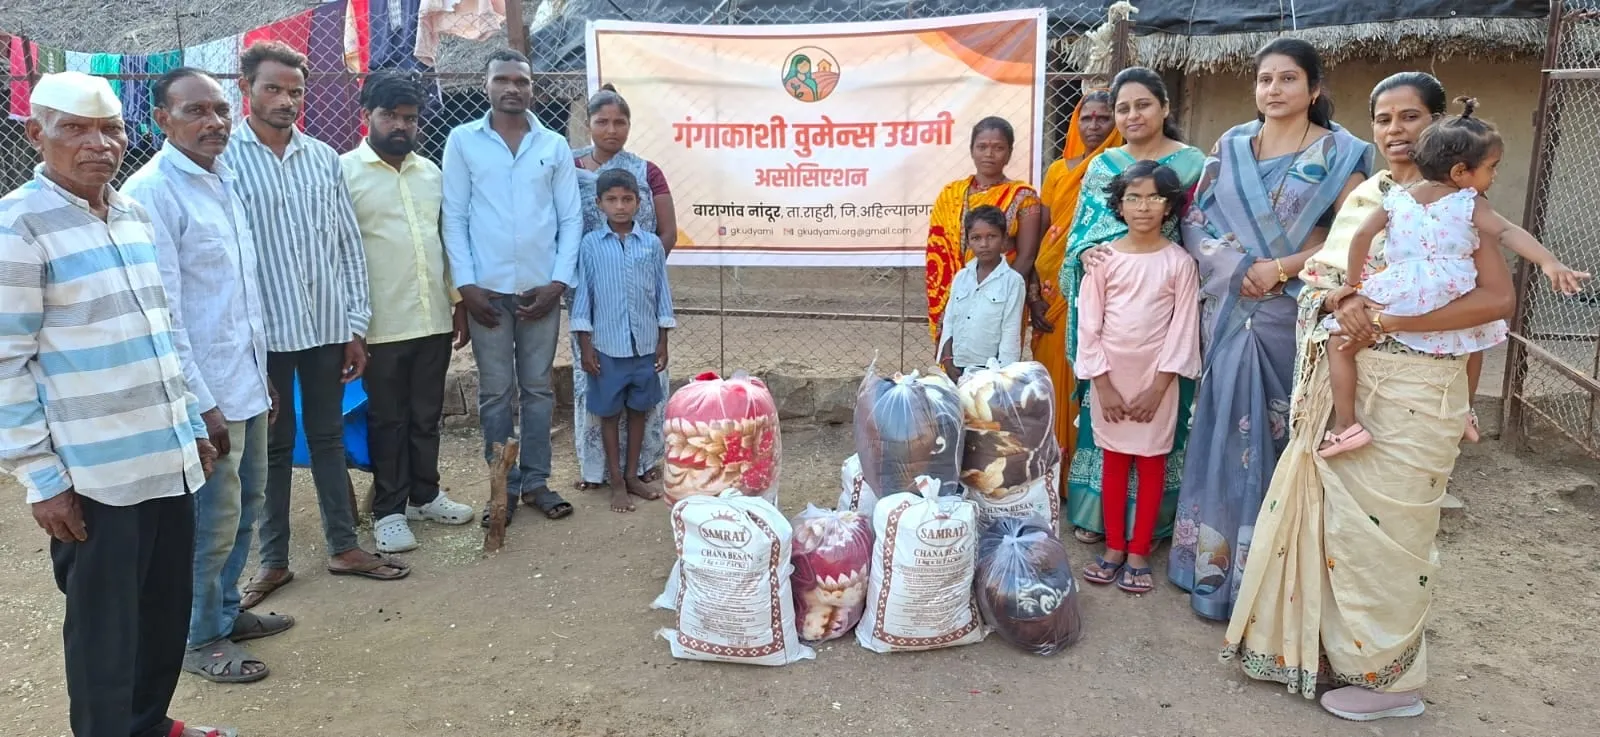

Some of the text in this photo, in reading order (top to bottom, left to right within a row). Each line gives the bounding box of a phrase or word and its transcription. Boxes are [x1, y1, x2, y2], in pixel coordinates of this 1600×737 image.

[672, 111, 955, 157] गंगाकाशी वुमेन्स उद्यमी
[755, 163, 869, 187] असोसिएशन
[747, 202, 784, 222] नांदूर,
[730, 227, 774, 237] gkudyami
[797, 226, 912, 237] gkudyami.org@gmail.com
[1010, 503, 1034, 513] BESAN
[701, 527, 746, 542] SAMRAT
[920, 526, 965, 539] SAMRAT
[701, 548, 753, 561] CHANA BESAN
[914, 547, 944, 557] CHANA
